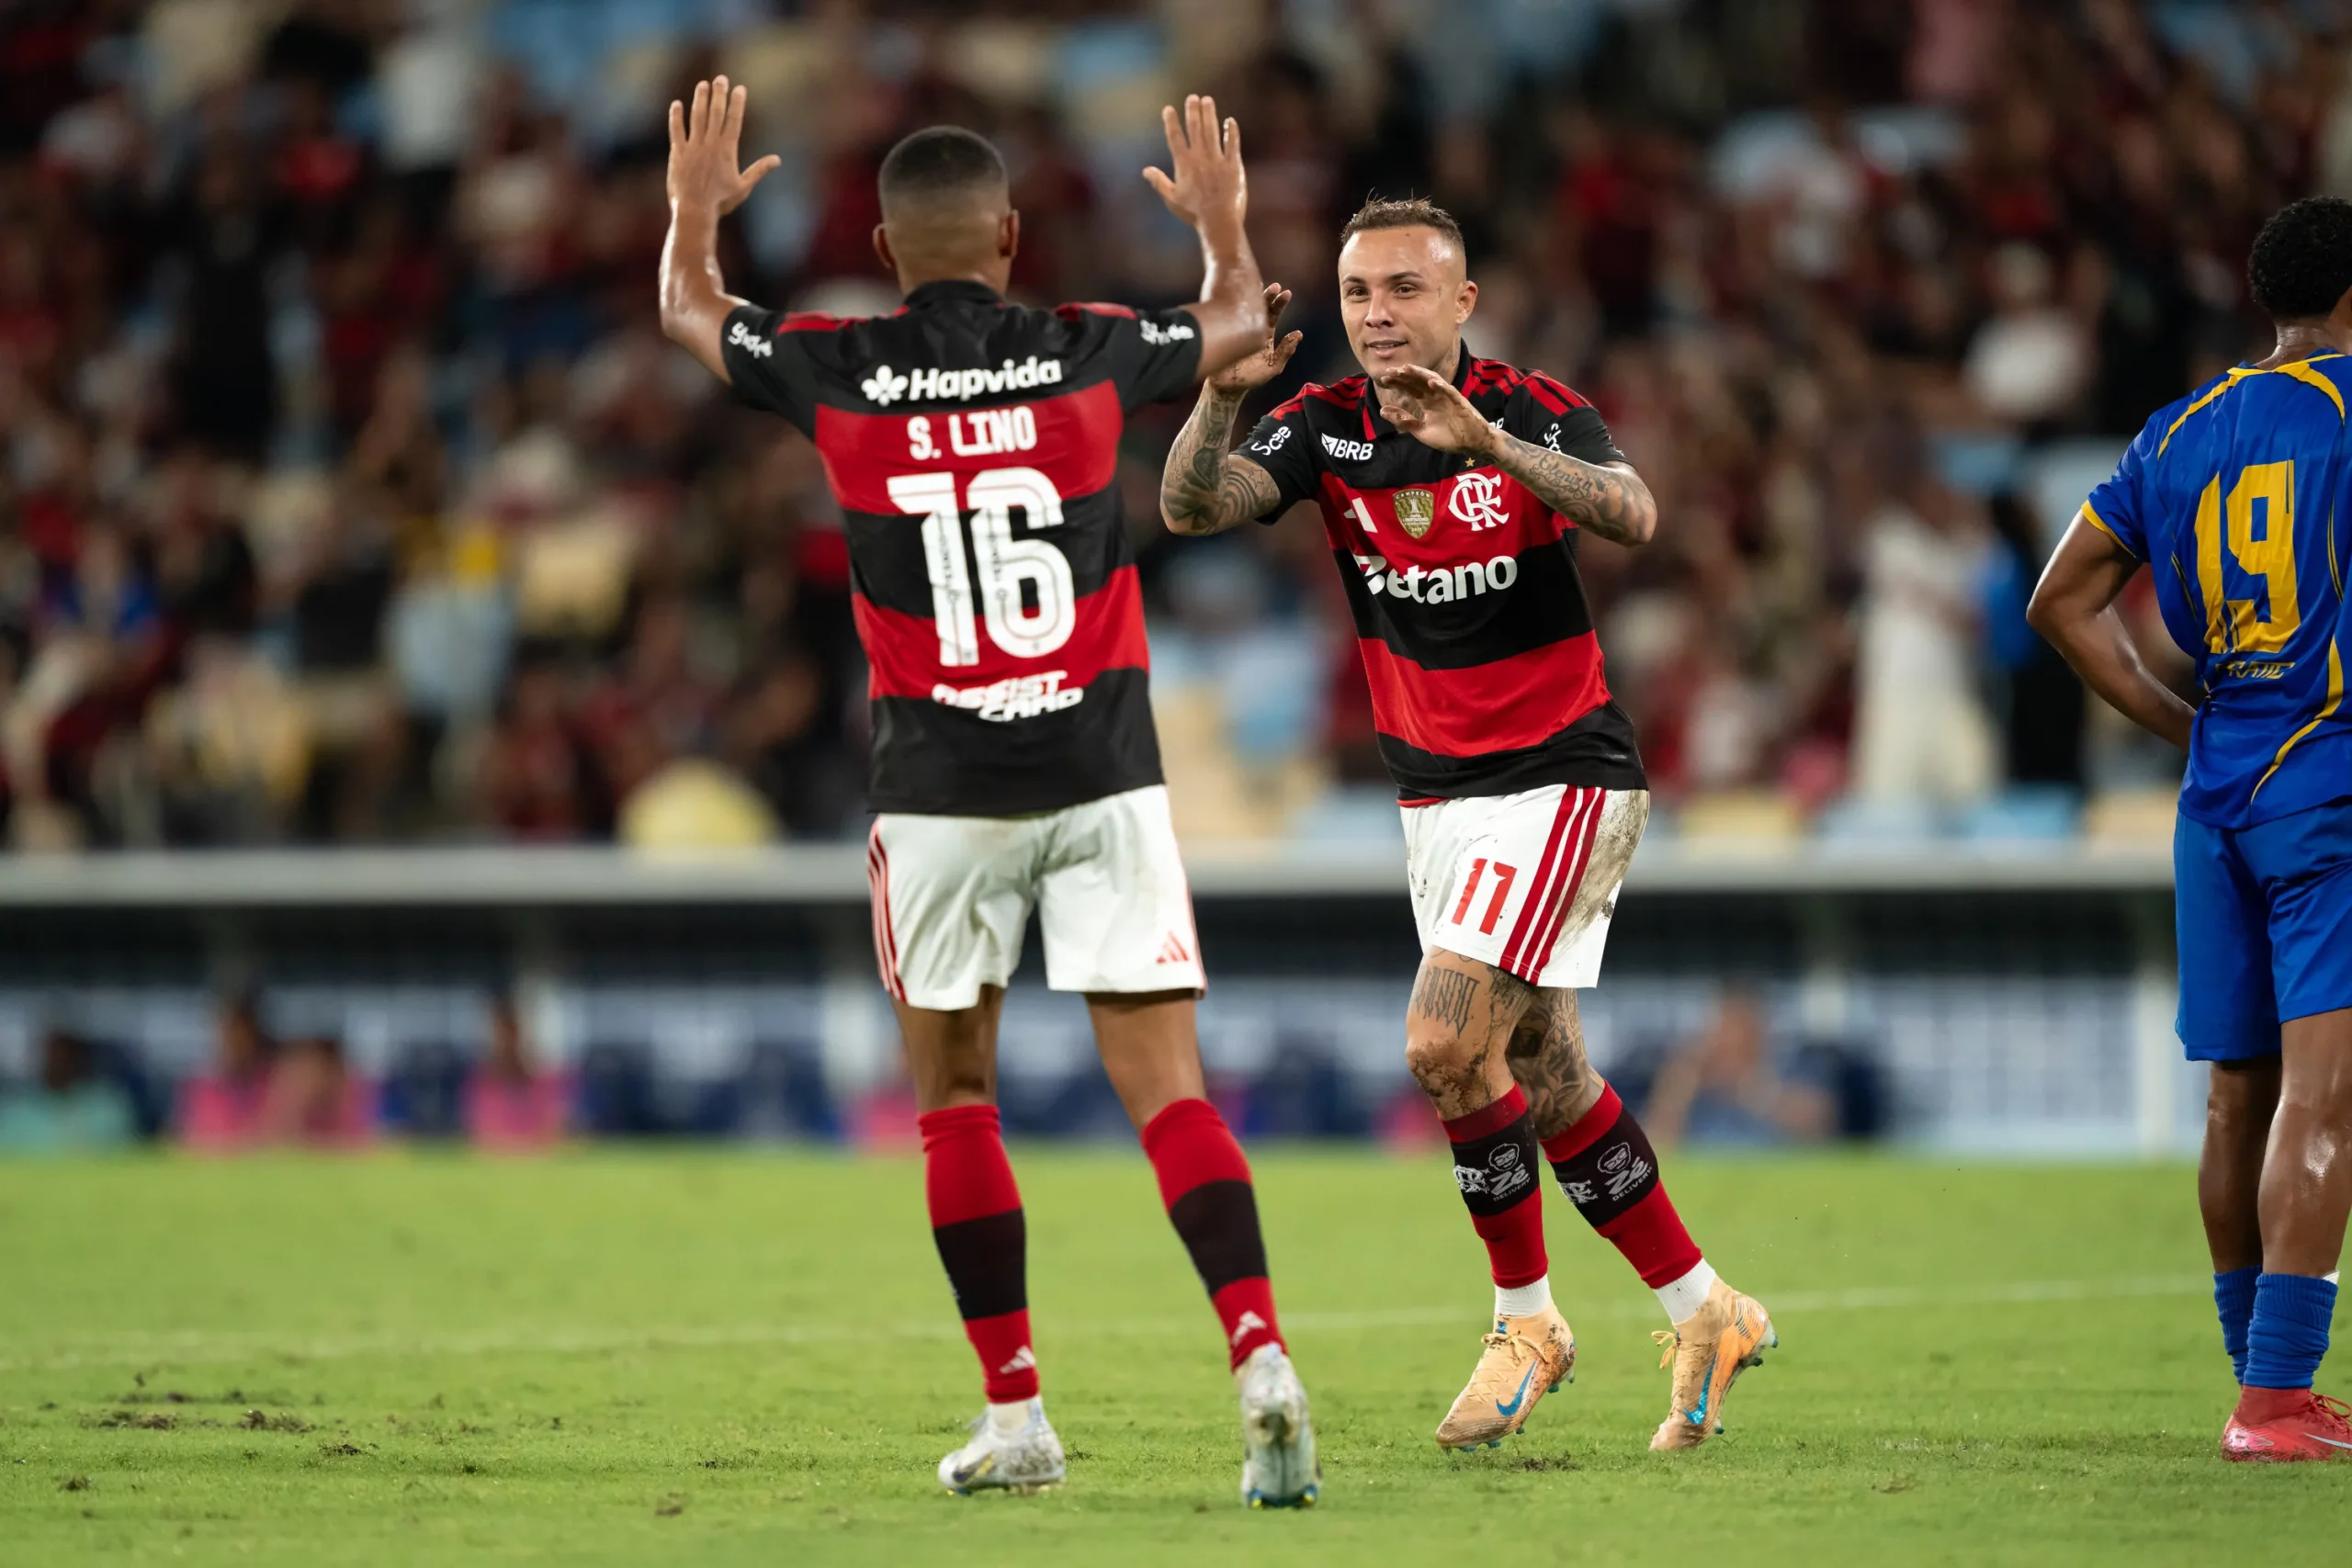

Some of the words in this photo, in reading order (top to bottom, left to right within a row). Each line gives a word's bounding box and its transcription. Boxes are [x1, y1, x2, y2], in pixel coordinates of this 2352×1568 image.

[909, 355, 1062, 402] Hapvida
[907, 415, 942, 460] S.
[948, 406, 1037, 457] LINO
[1334, 439, 1374, 461] BRB
[887, 468, 1075, 667] 16
[1353, 554, 1518, 605] Betano
[2194, 459, 2301, 654] 19
[1452, 858, 1518, 936] 11
